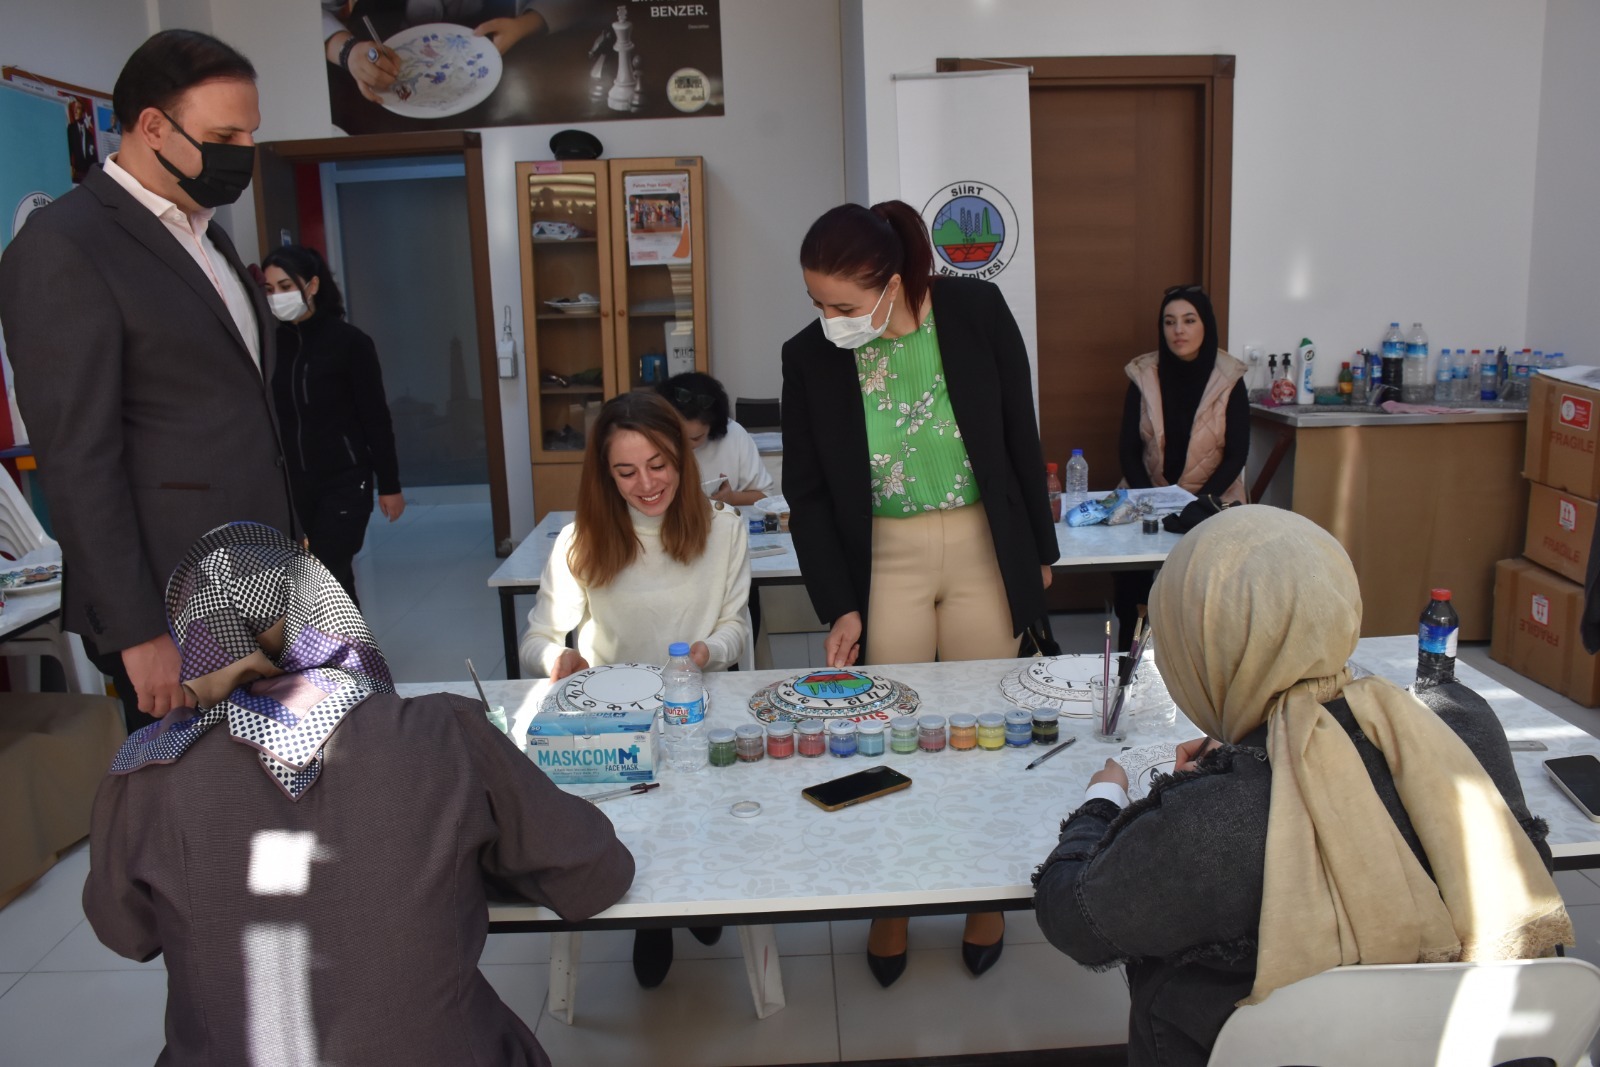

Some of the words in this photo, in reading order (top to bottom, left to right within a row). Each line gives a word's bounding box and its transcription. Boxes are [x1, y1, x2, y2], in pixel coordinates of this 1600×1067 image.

[650, 4, 708, 17] BENZER.
[951, 184, 983, 197] SİİRT
[1551, 430, 1594, 454] FRAGILE
[1543, 536, 1581, 563] FRAGILE
